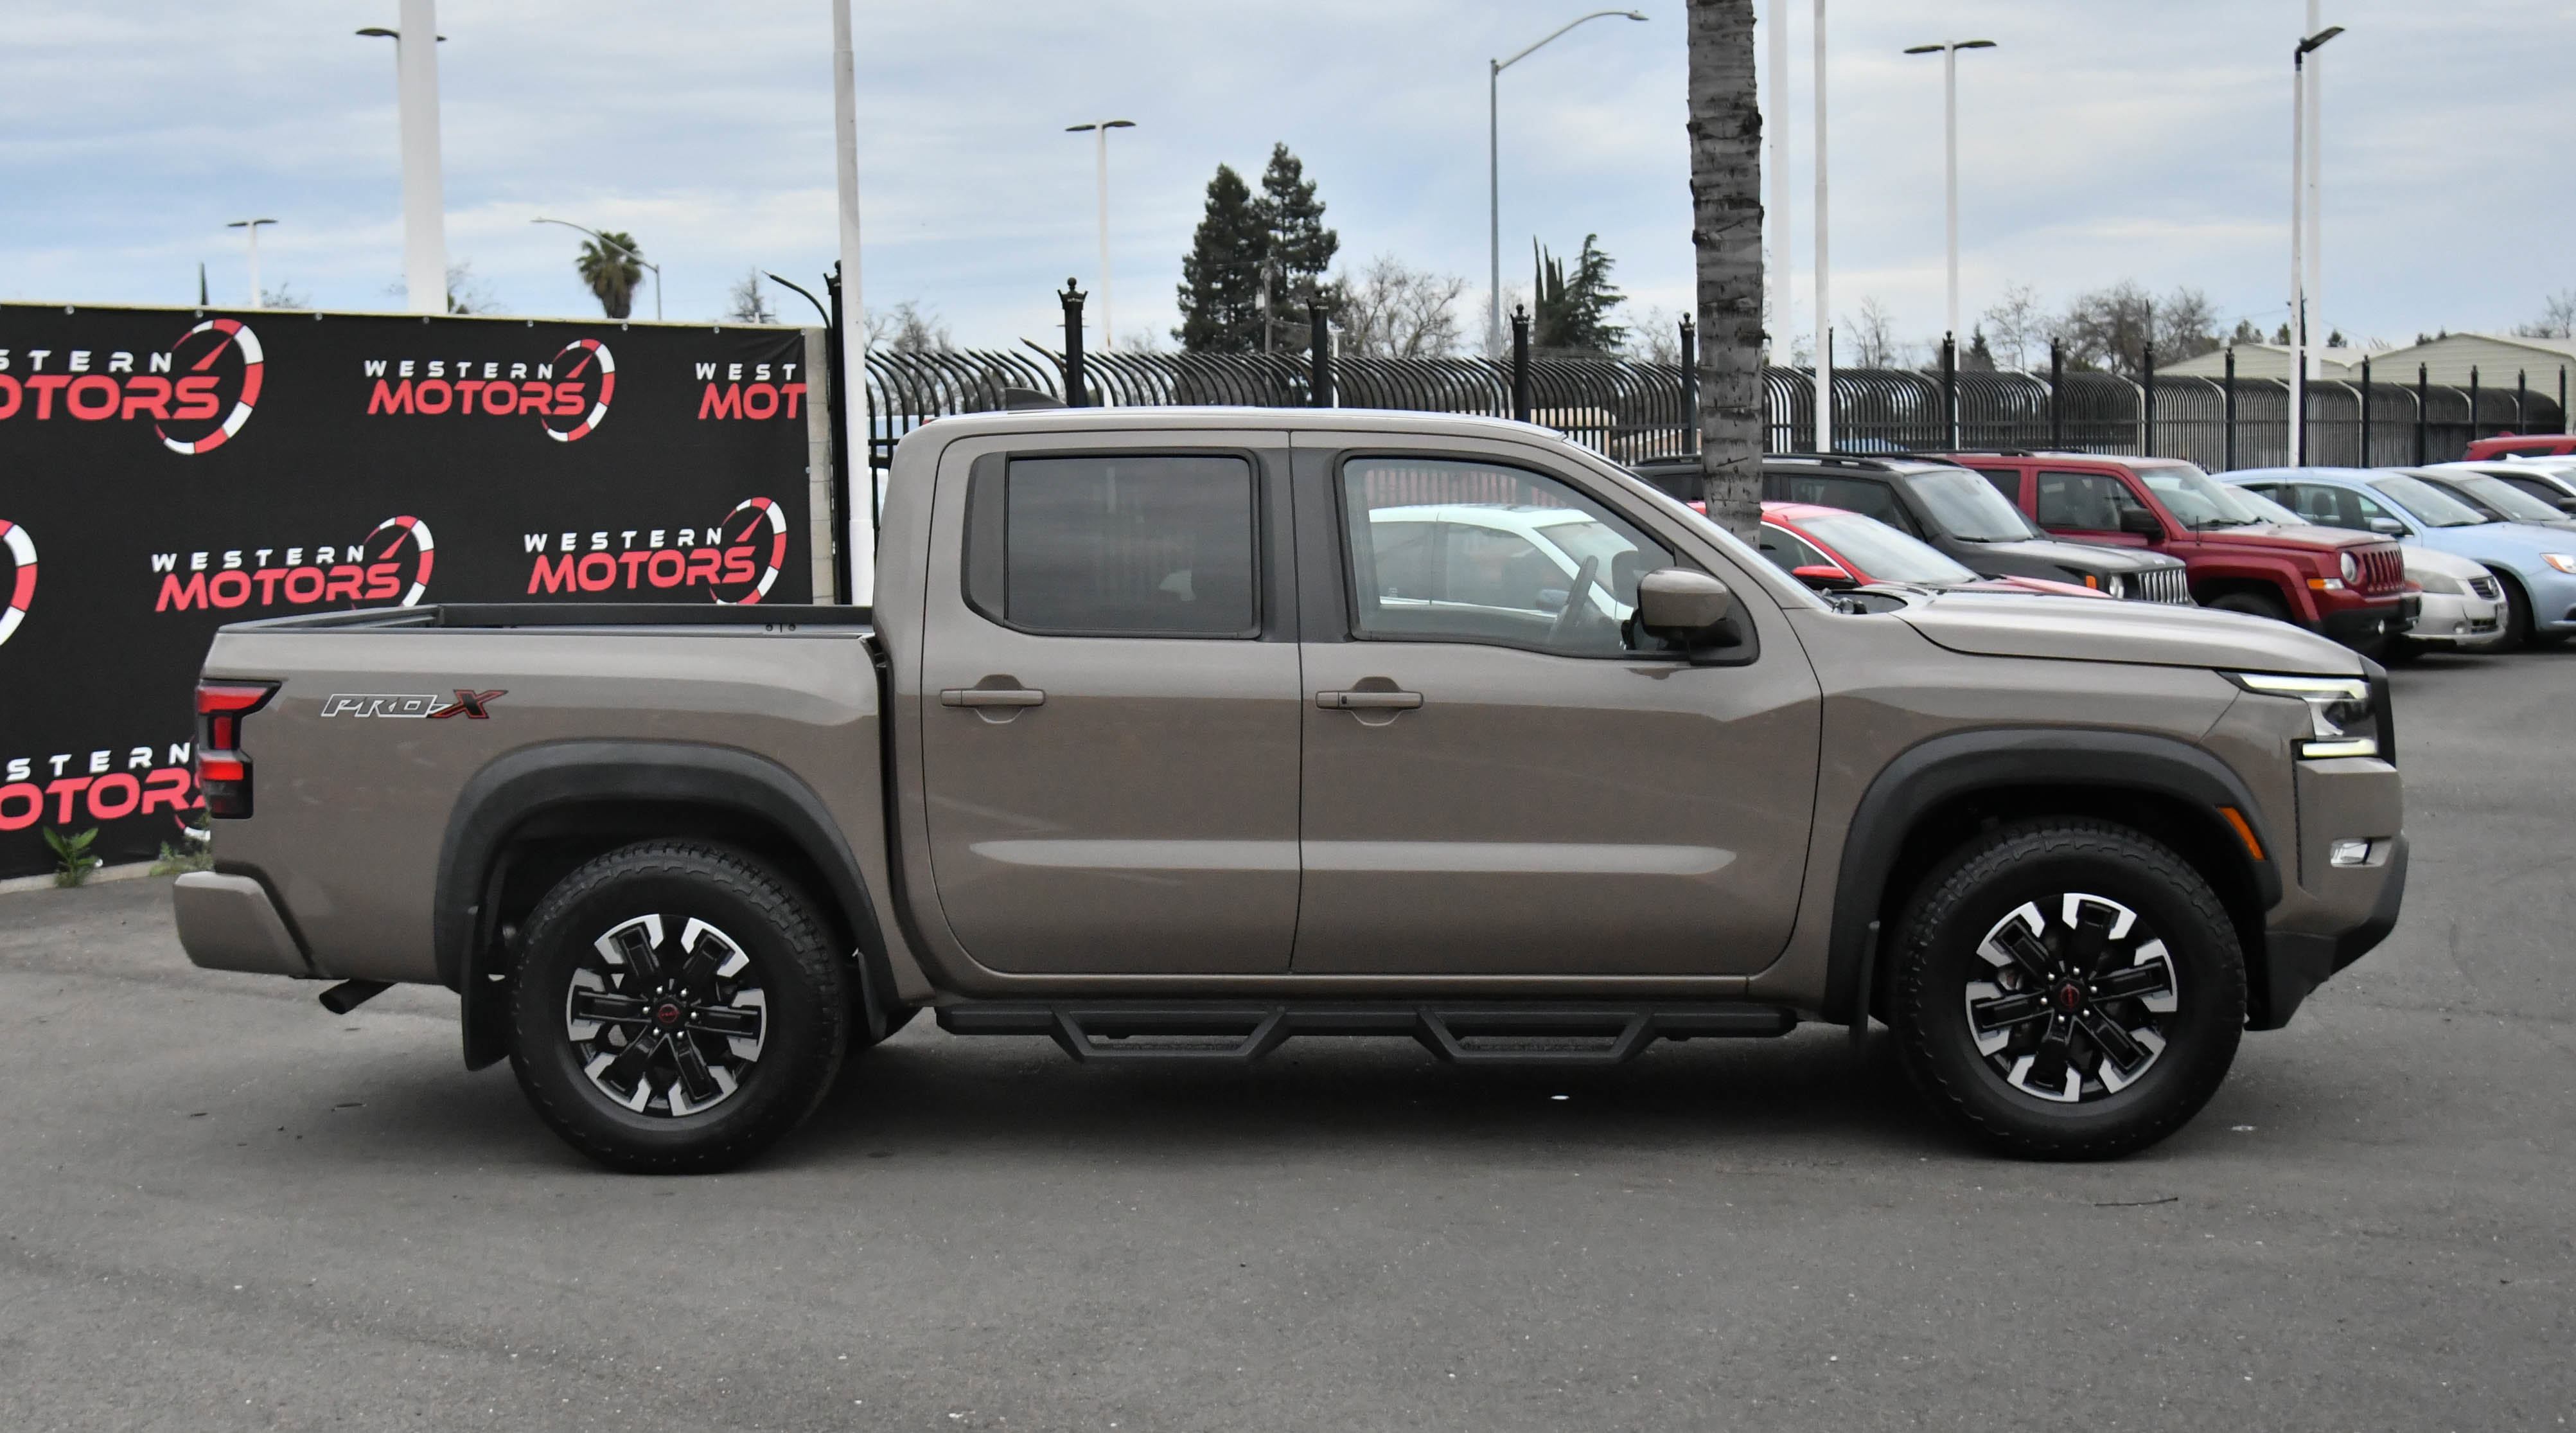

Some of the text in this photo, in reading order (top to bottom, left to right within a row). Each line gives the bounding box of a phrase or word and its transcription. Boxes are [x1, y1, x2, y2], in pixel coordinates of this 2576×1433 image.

[364, 360, 554, 380] WESTERN
[695, 362, 797, 381] WEST
[367, 379, 586, 416] MOTORS
[698, 382, 807, 420] MOT
[523, 526, 722, 553] WESTERN
[150, 544, 365, 573] WESTERN
[527, 545, 757, 595] MOTORS
[154, 562, 401, 613] MOTORS
[5, 741, 191, 783] STERN
